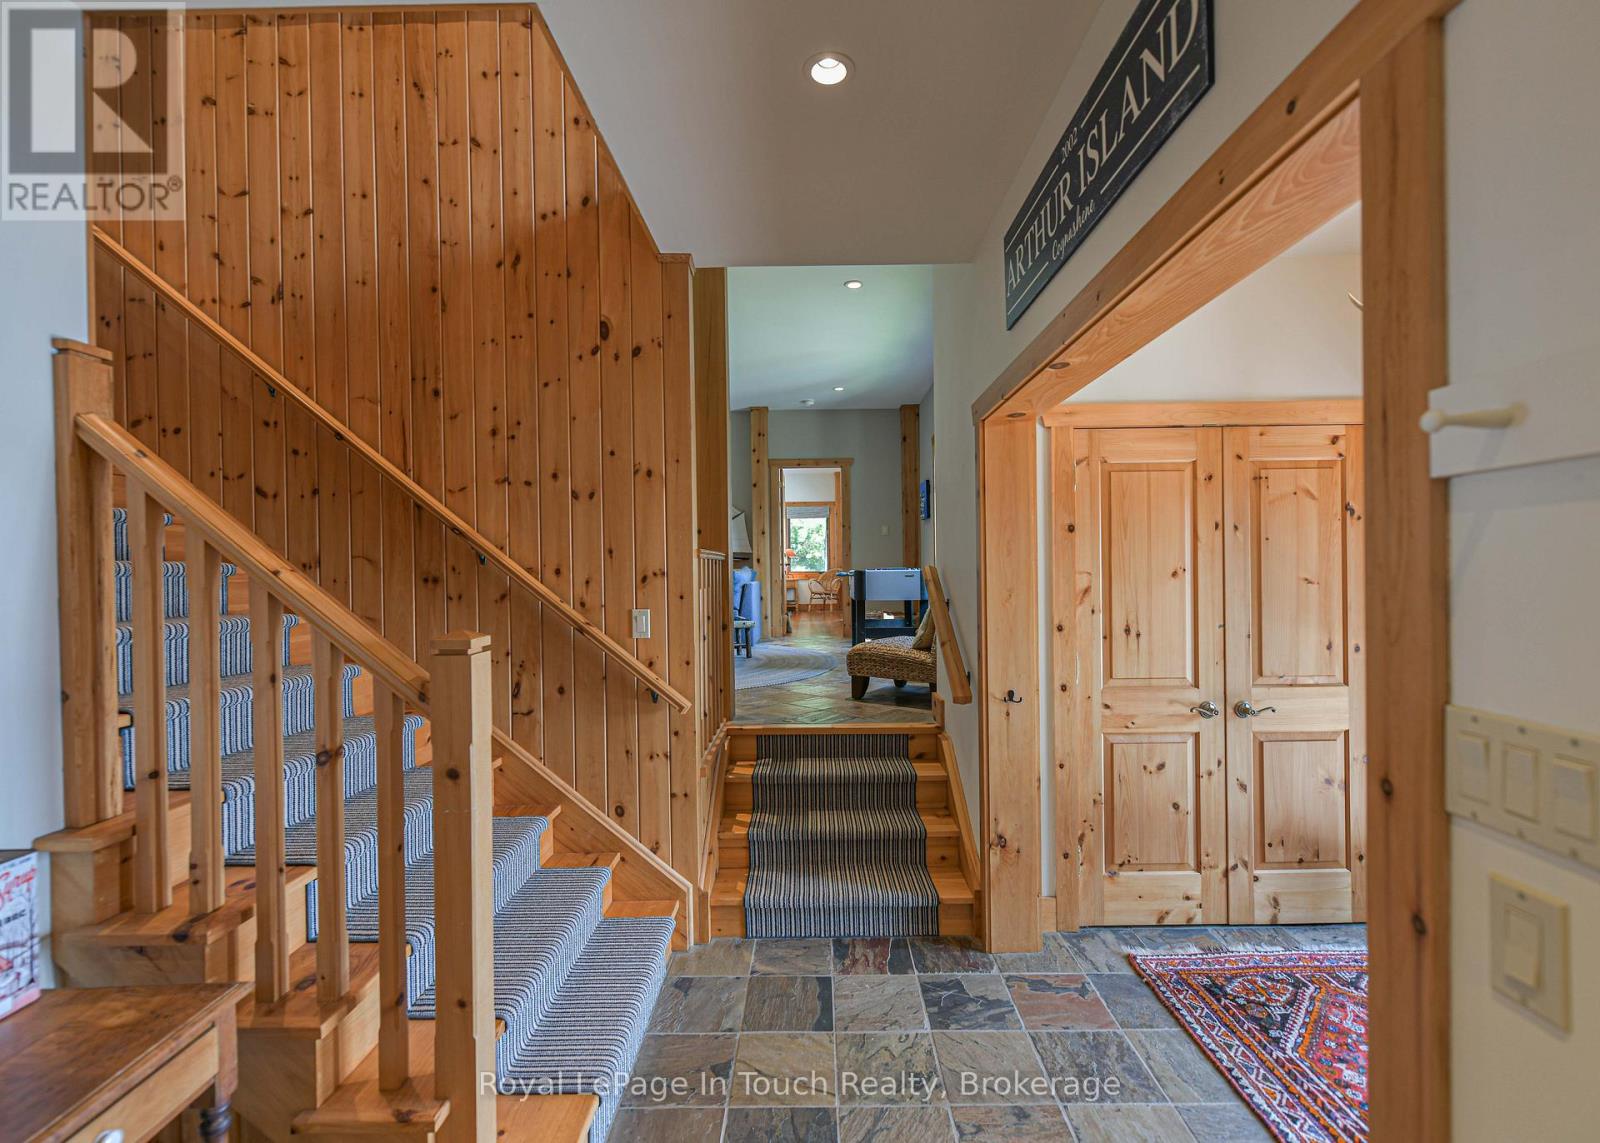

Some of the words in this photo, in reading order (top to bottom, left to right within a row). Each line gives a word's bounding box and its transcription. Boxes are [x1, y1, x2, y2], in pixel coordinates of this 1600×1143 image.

[1007, 171, 1074, 297] ARTHUR
[1078, 0, 1199, 198] ISLAND
[1061, 127, 1078, 165] 2002
